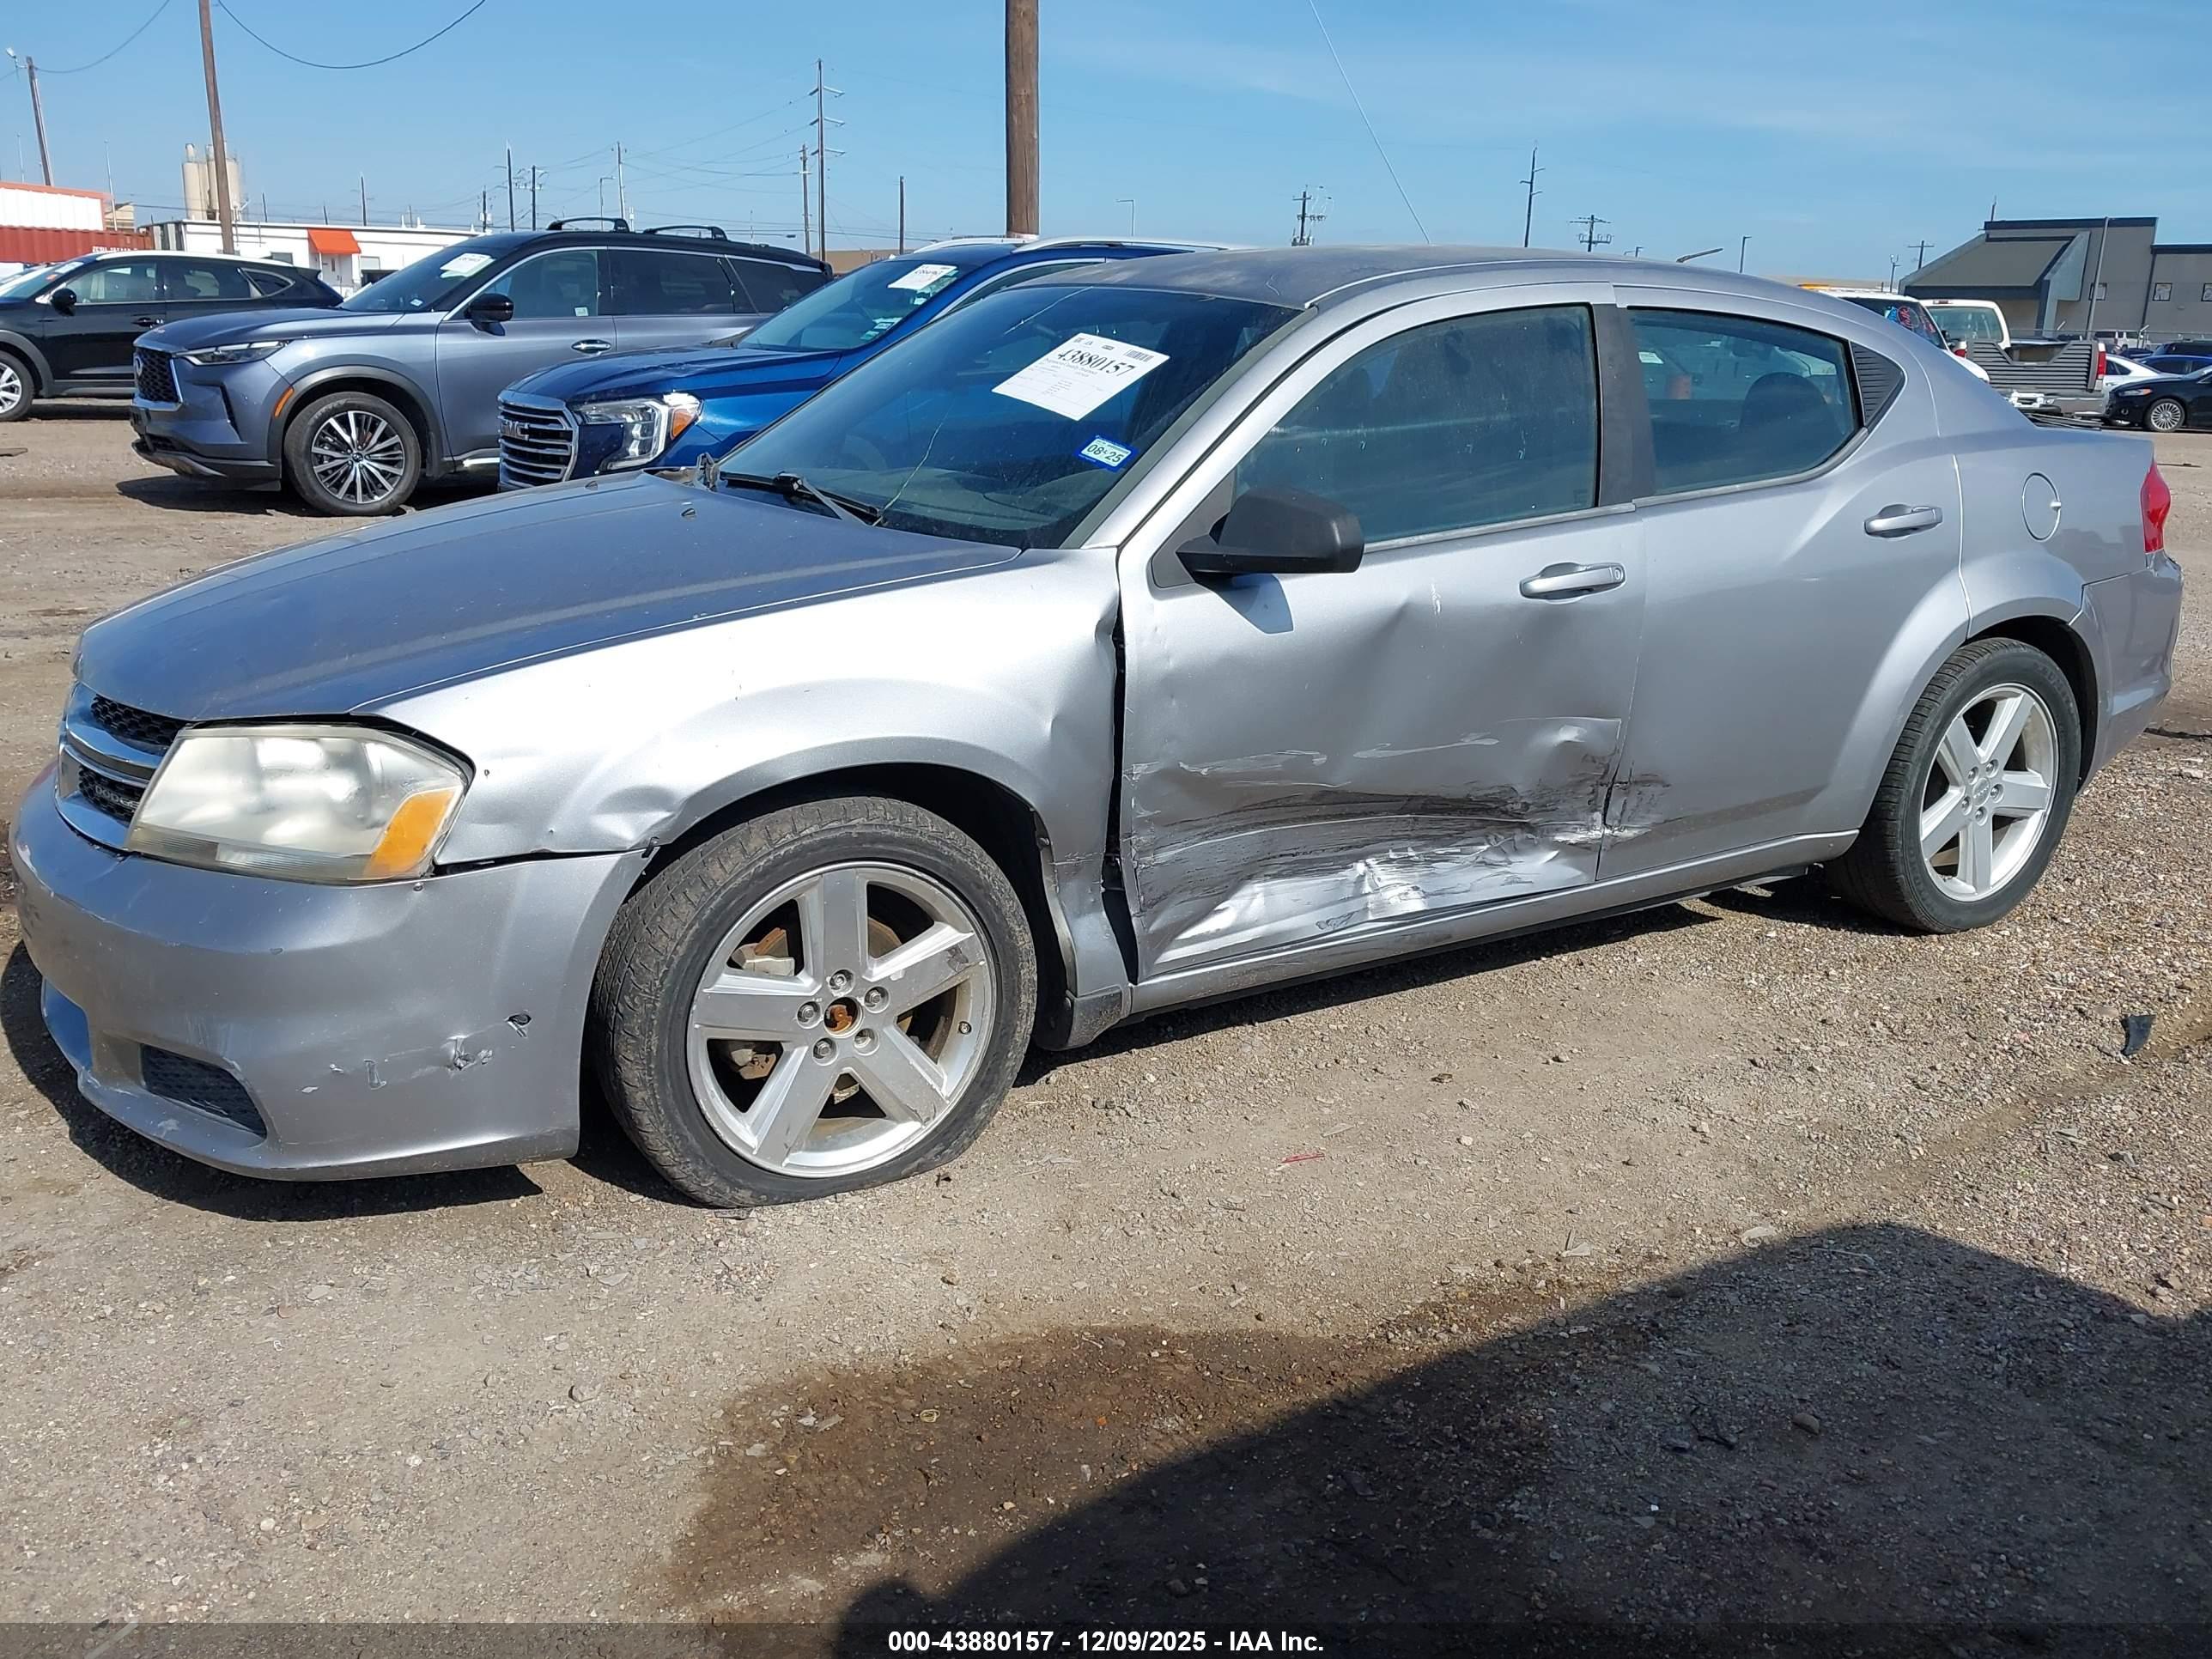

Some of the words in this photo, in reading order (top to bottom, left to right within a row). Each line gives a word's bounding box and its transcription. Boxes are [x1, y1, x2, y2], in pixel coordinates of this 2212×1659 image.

[1058, 349, 1136, 377] 43880157
[1087, 444, 1105, 455] 08
[1104, 451, 1124, 463] 25
